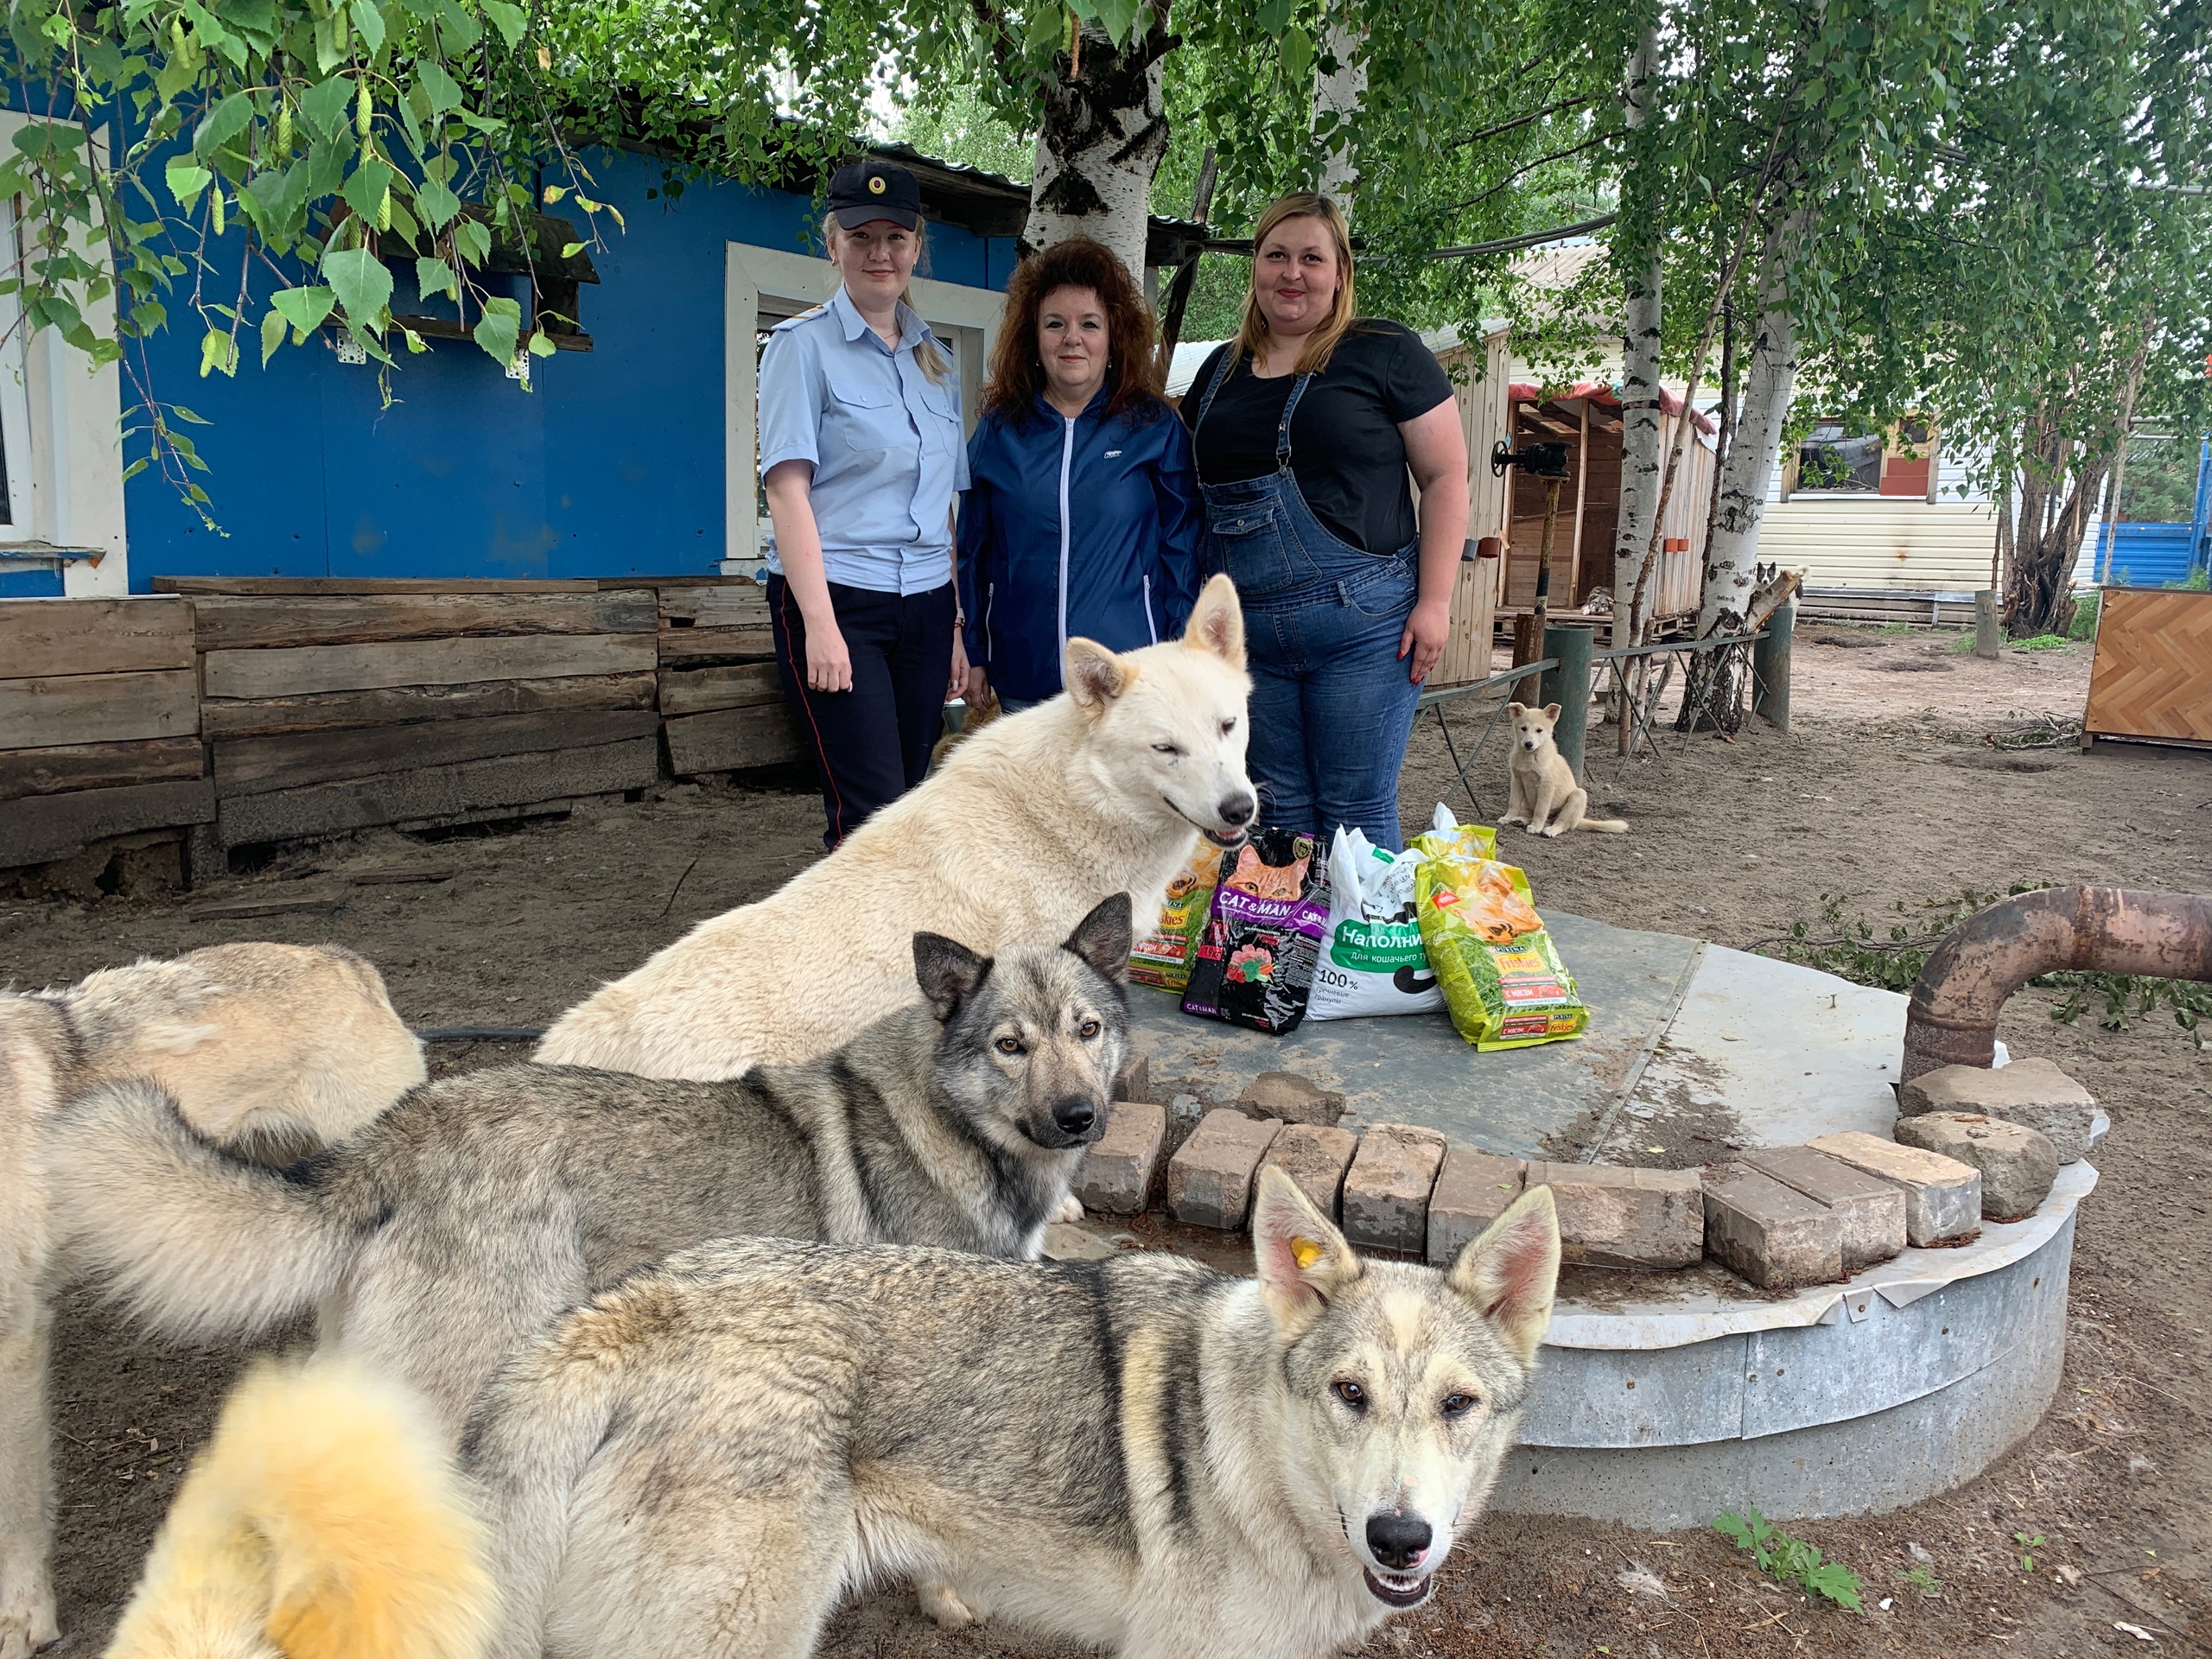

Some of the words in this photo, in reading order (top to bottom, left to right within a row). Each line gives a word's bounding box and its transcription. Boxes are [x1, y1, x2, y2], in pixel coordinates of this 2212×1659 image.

[1160, 912, 1183, 925] skies
[1342, 925, 1423, 948] Наполни
[1351, 951, 1368, 961] для
[1371, 954, 1417, 963] кошачьего
[1499, 957, 1541, 970] Friskies
[1316, 987, 1350, 998] гречневые
[1314, 994, 1342, 1004] гранулы
[1550, 1022, 1574, 1032] Friskies
